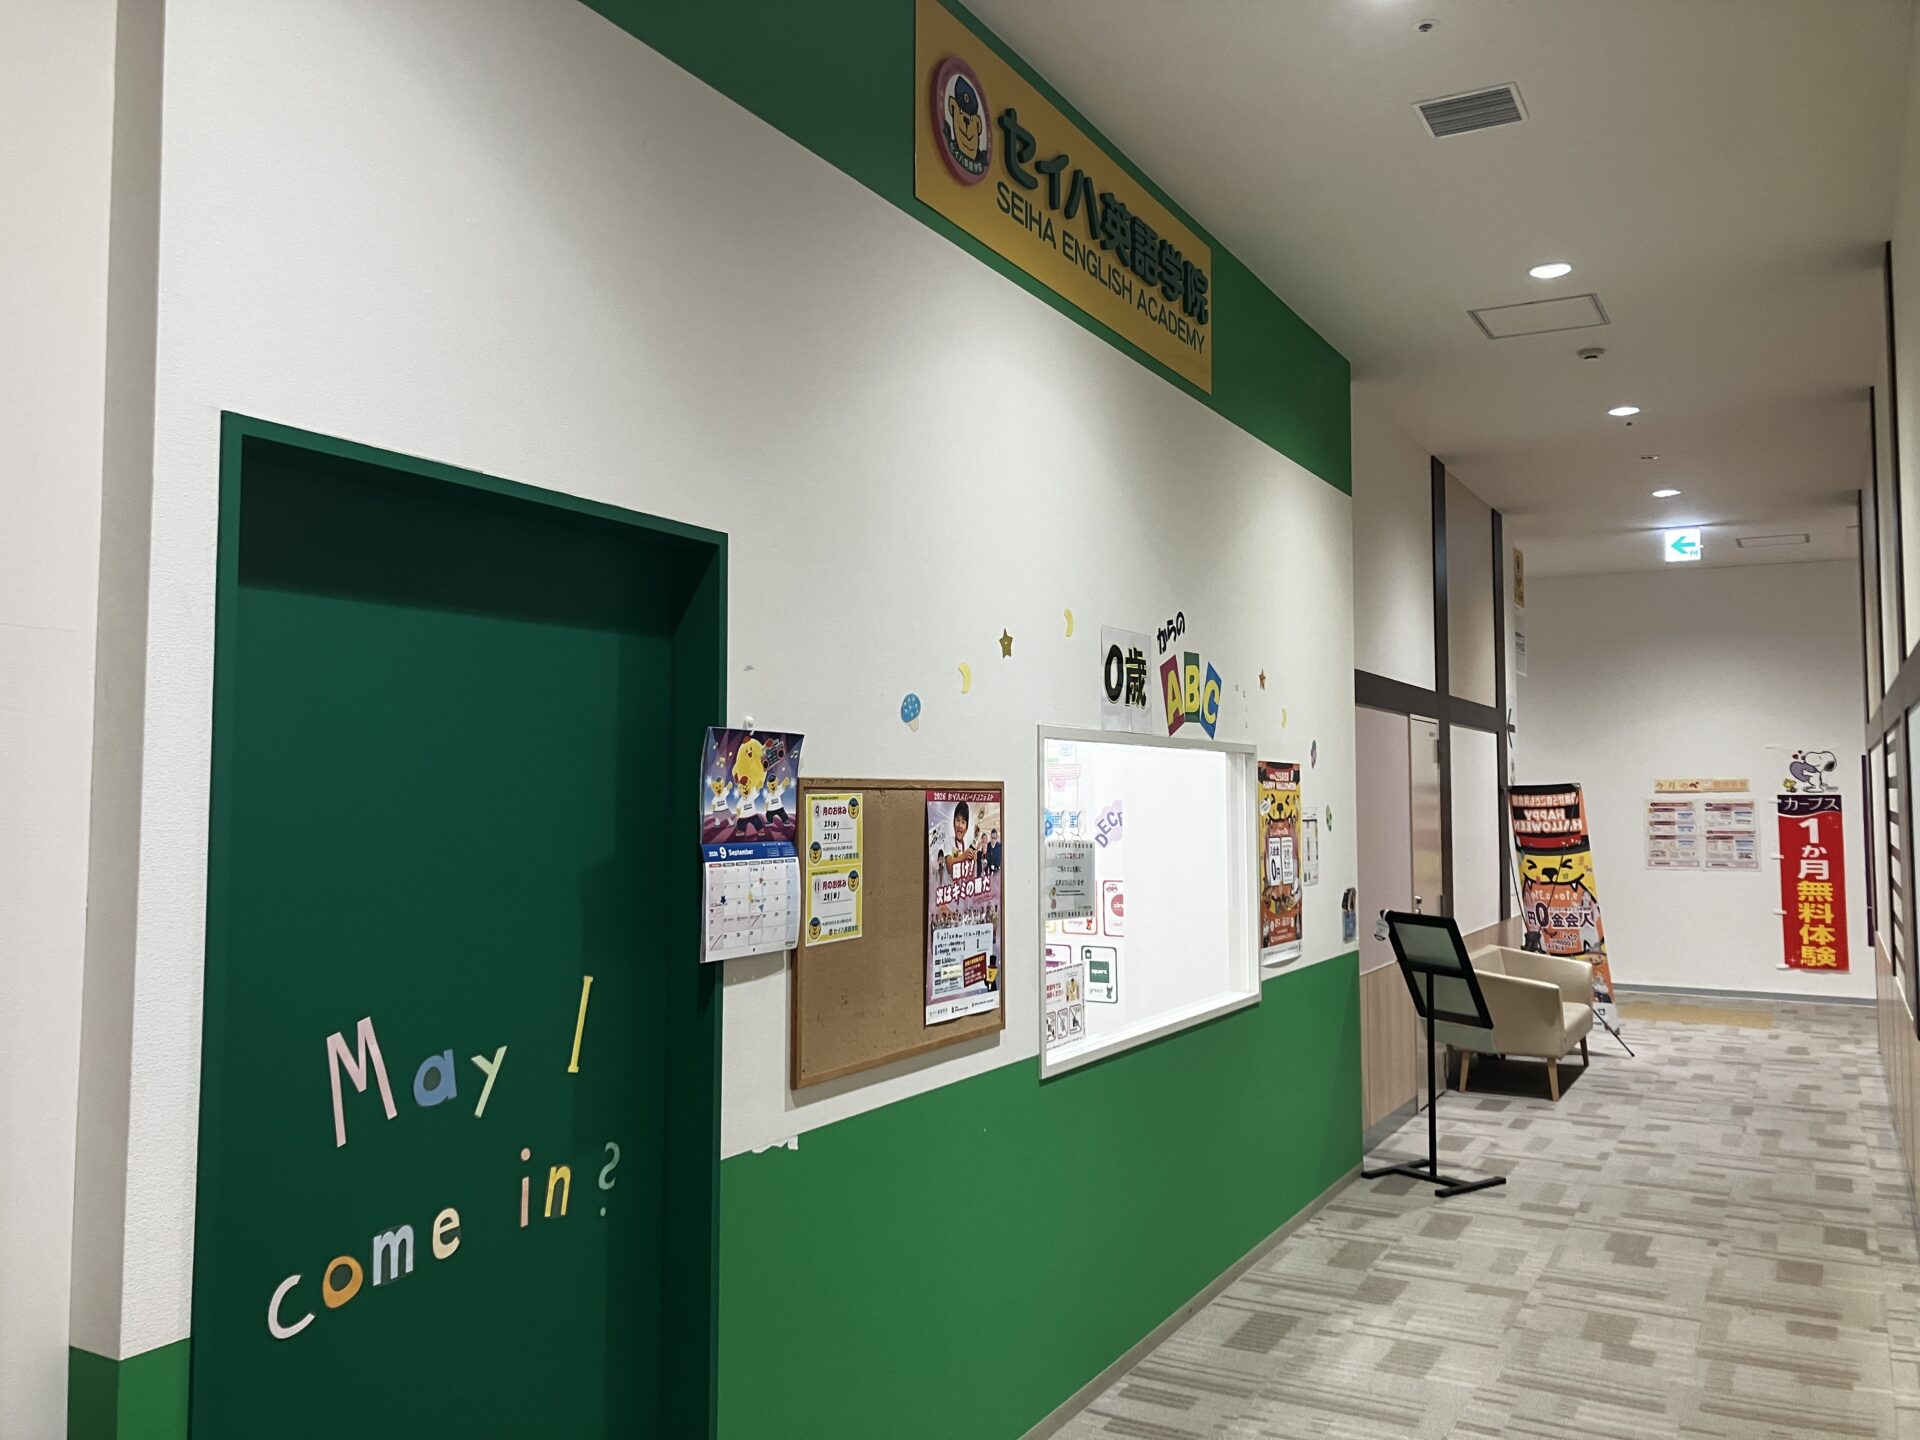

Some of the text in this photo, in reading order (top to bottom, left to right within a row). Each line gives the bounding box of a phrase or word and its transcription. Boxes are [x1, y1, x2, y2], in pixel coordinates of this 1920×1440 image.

[998, 108, 1209, 325] セイハ英語学院
[996, 181, 1205, 354] SEIHA ENGLISH ACADEMY
[1104, 644, 1147, 709] 0歳
[1157, 611, 1185, 654] からの
[1167, 664, 1220, 726] ABC
[719, 847, 726, 859] 9
[1797, 818, 1838, 968] 1か月無料体験
[326, 1015, 508, 1148] May
